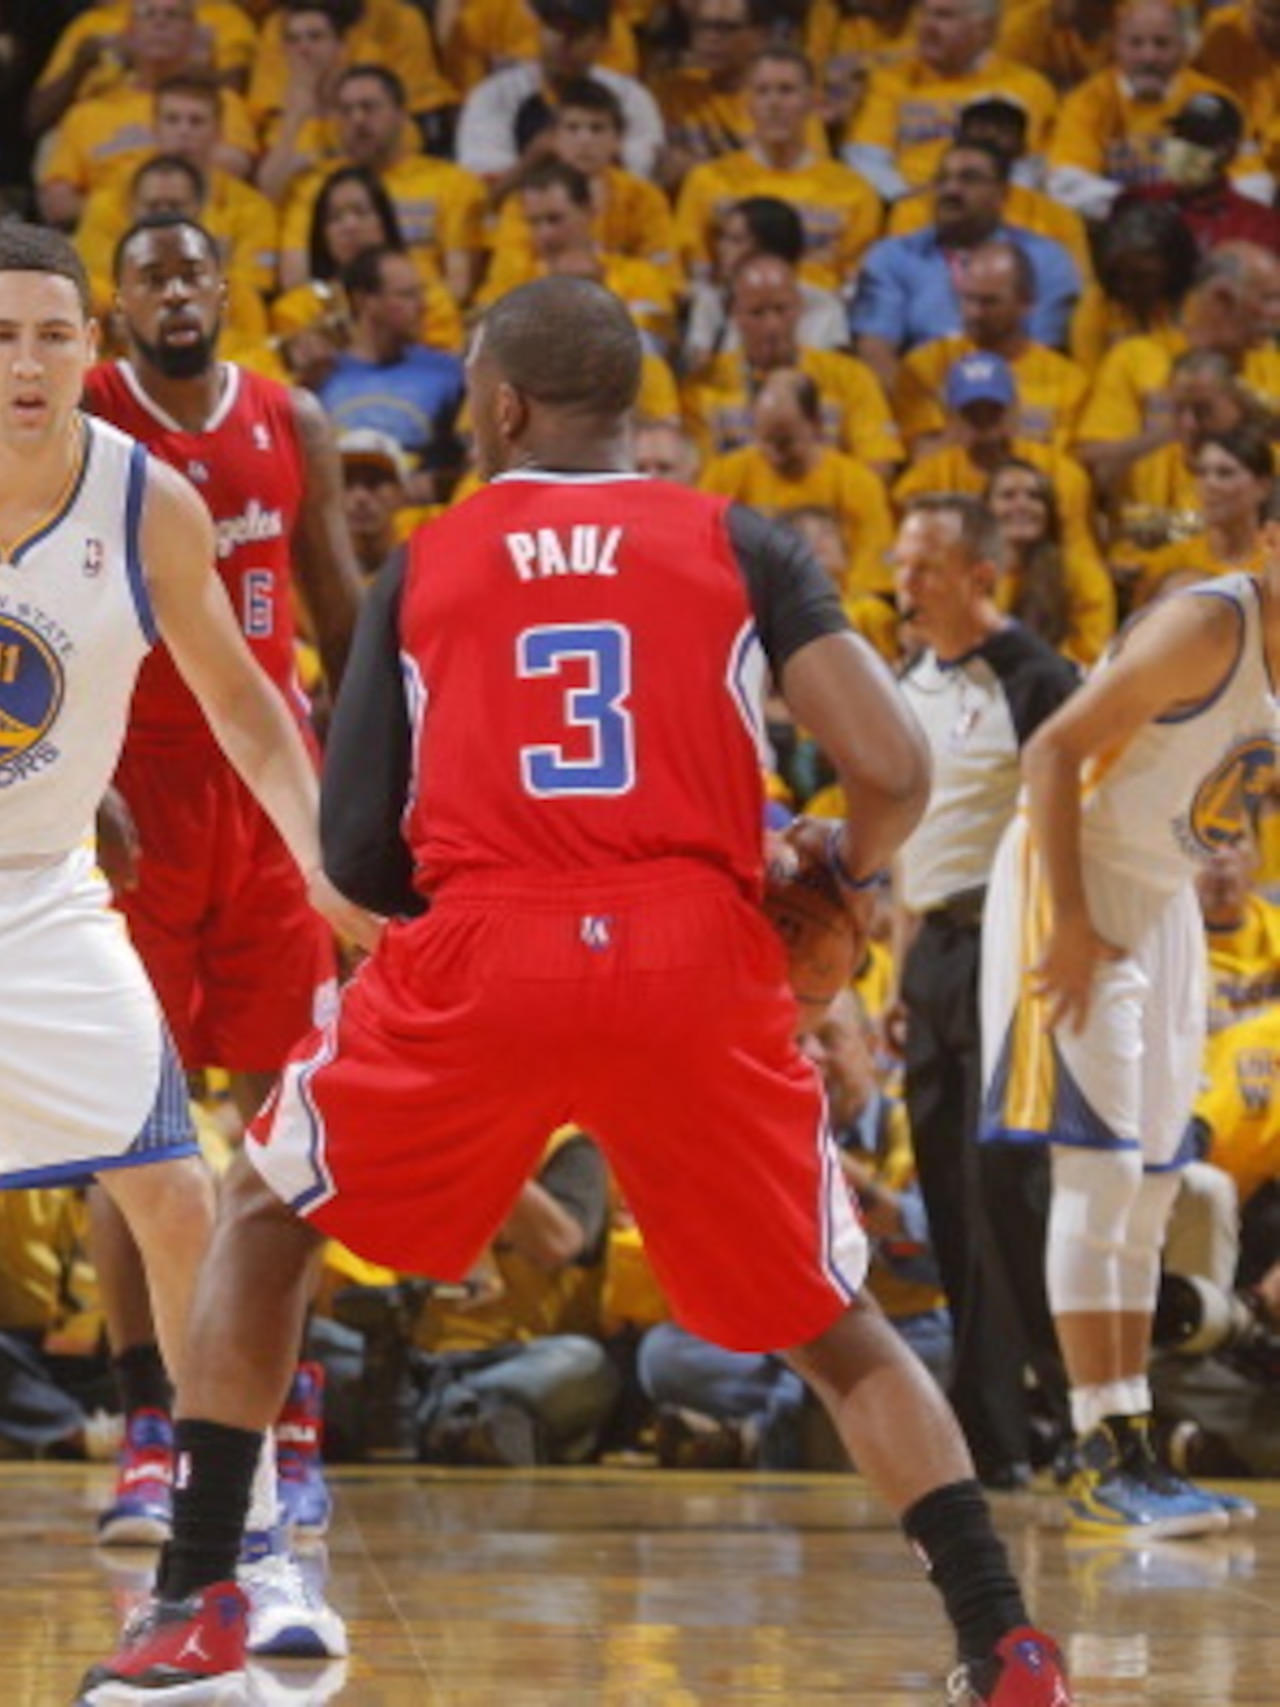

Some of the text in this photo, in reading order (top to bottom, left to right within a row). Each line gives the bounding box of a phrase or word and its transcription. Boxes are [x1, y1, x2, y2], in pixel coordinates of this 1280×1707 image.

[504, 525, 623, 583] PAUL
[17, 602, 77, 658] STATE
[243, 568, 274, 638] 6
[515, 620, 636, 798] 3
